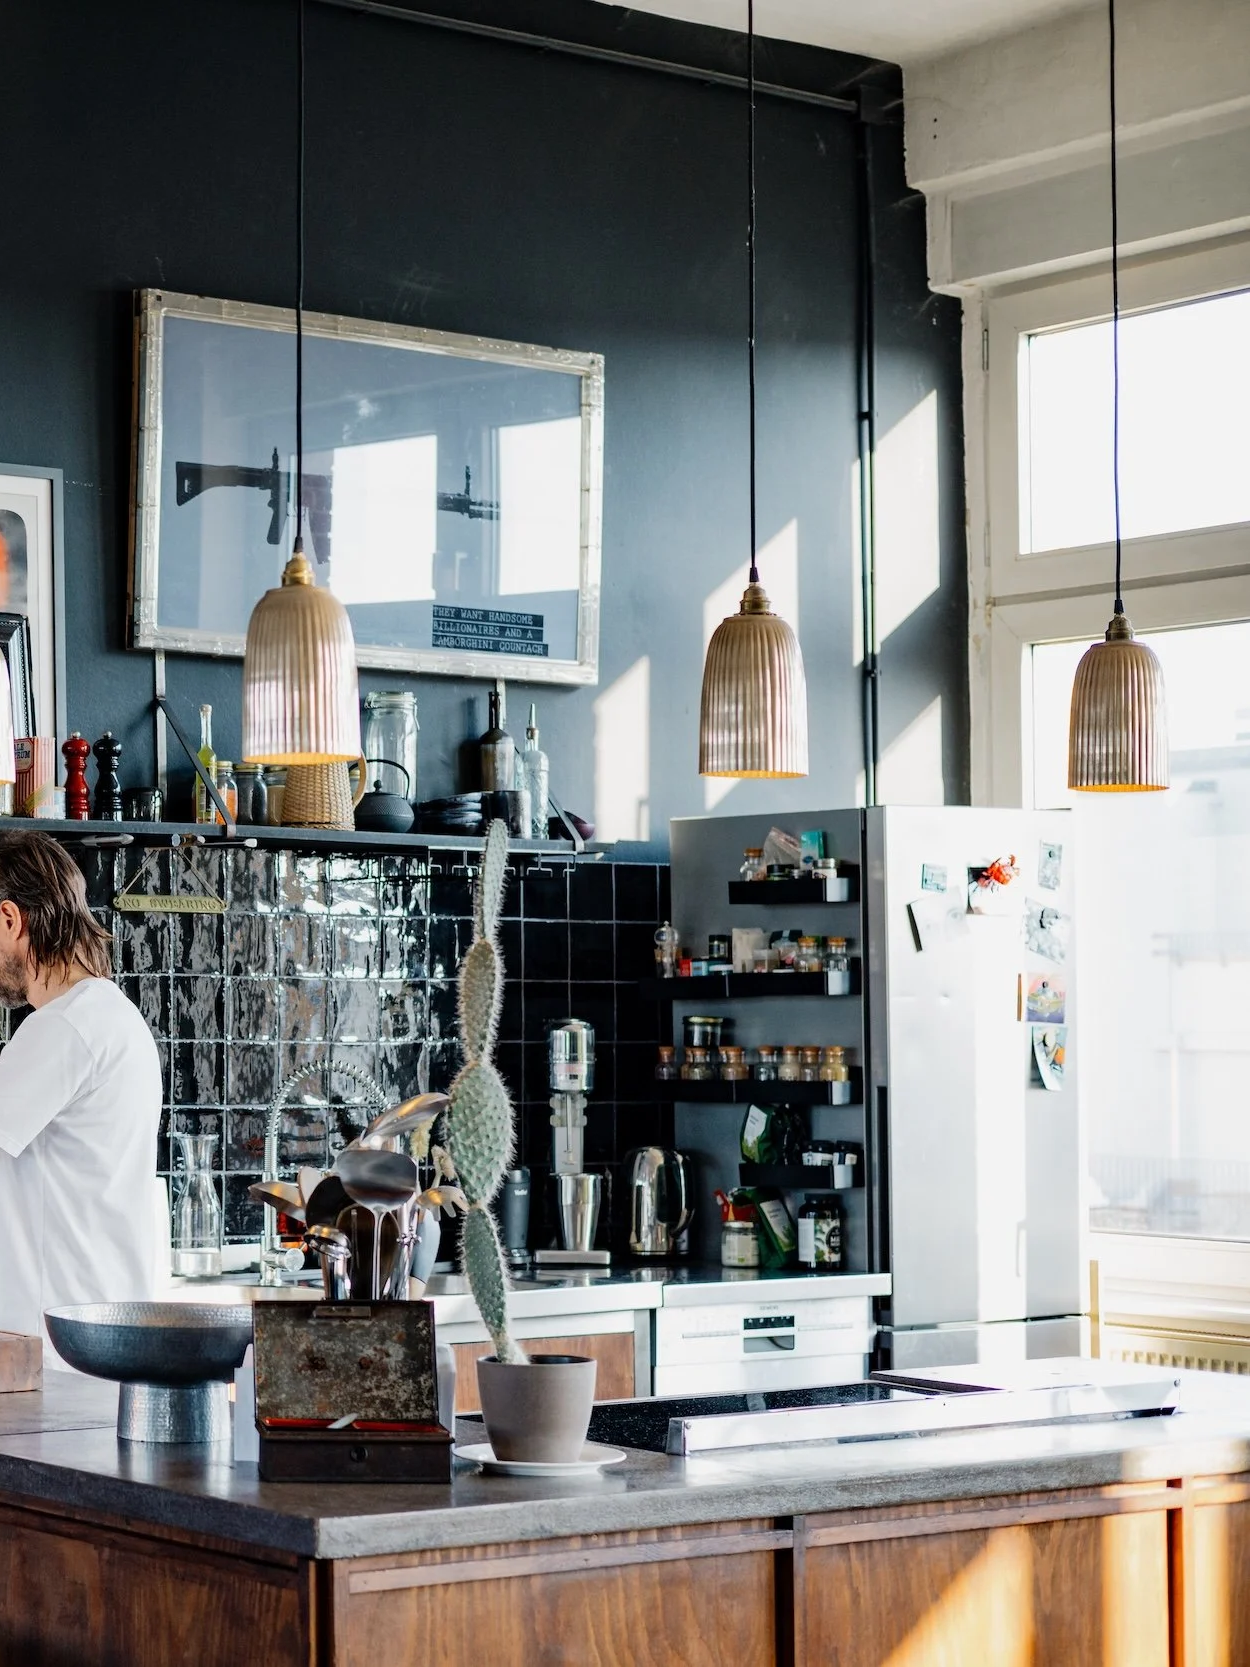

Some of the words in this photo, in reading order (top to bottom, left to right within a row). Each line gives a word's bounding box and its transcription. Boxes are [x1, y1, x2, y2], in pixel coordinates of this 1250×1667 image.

[433, 606, 455, 617] THEY
[460, 609, 483, 620] WANT
[488, 611, 533, 625] HANDSOME
[433, 620, 500, 636] BILLIONAIRES
[505, 627, 522, 638] AND
[526, 629, 533, 639] A
[432, 635, 493, 650] LAMBORGHINI
[499, 641, 543, 655] COUNTACH
[123, 897, 140, 908] NO
